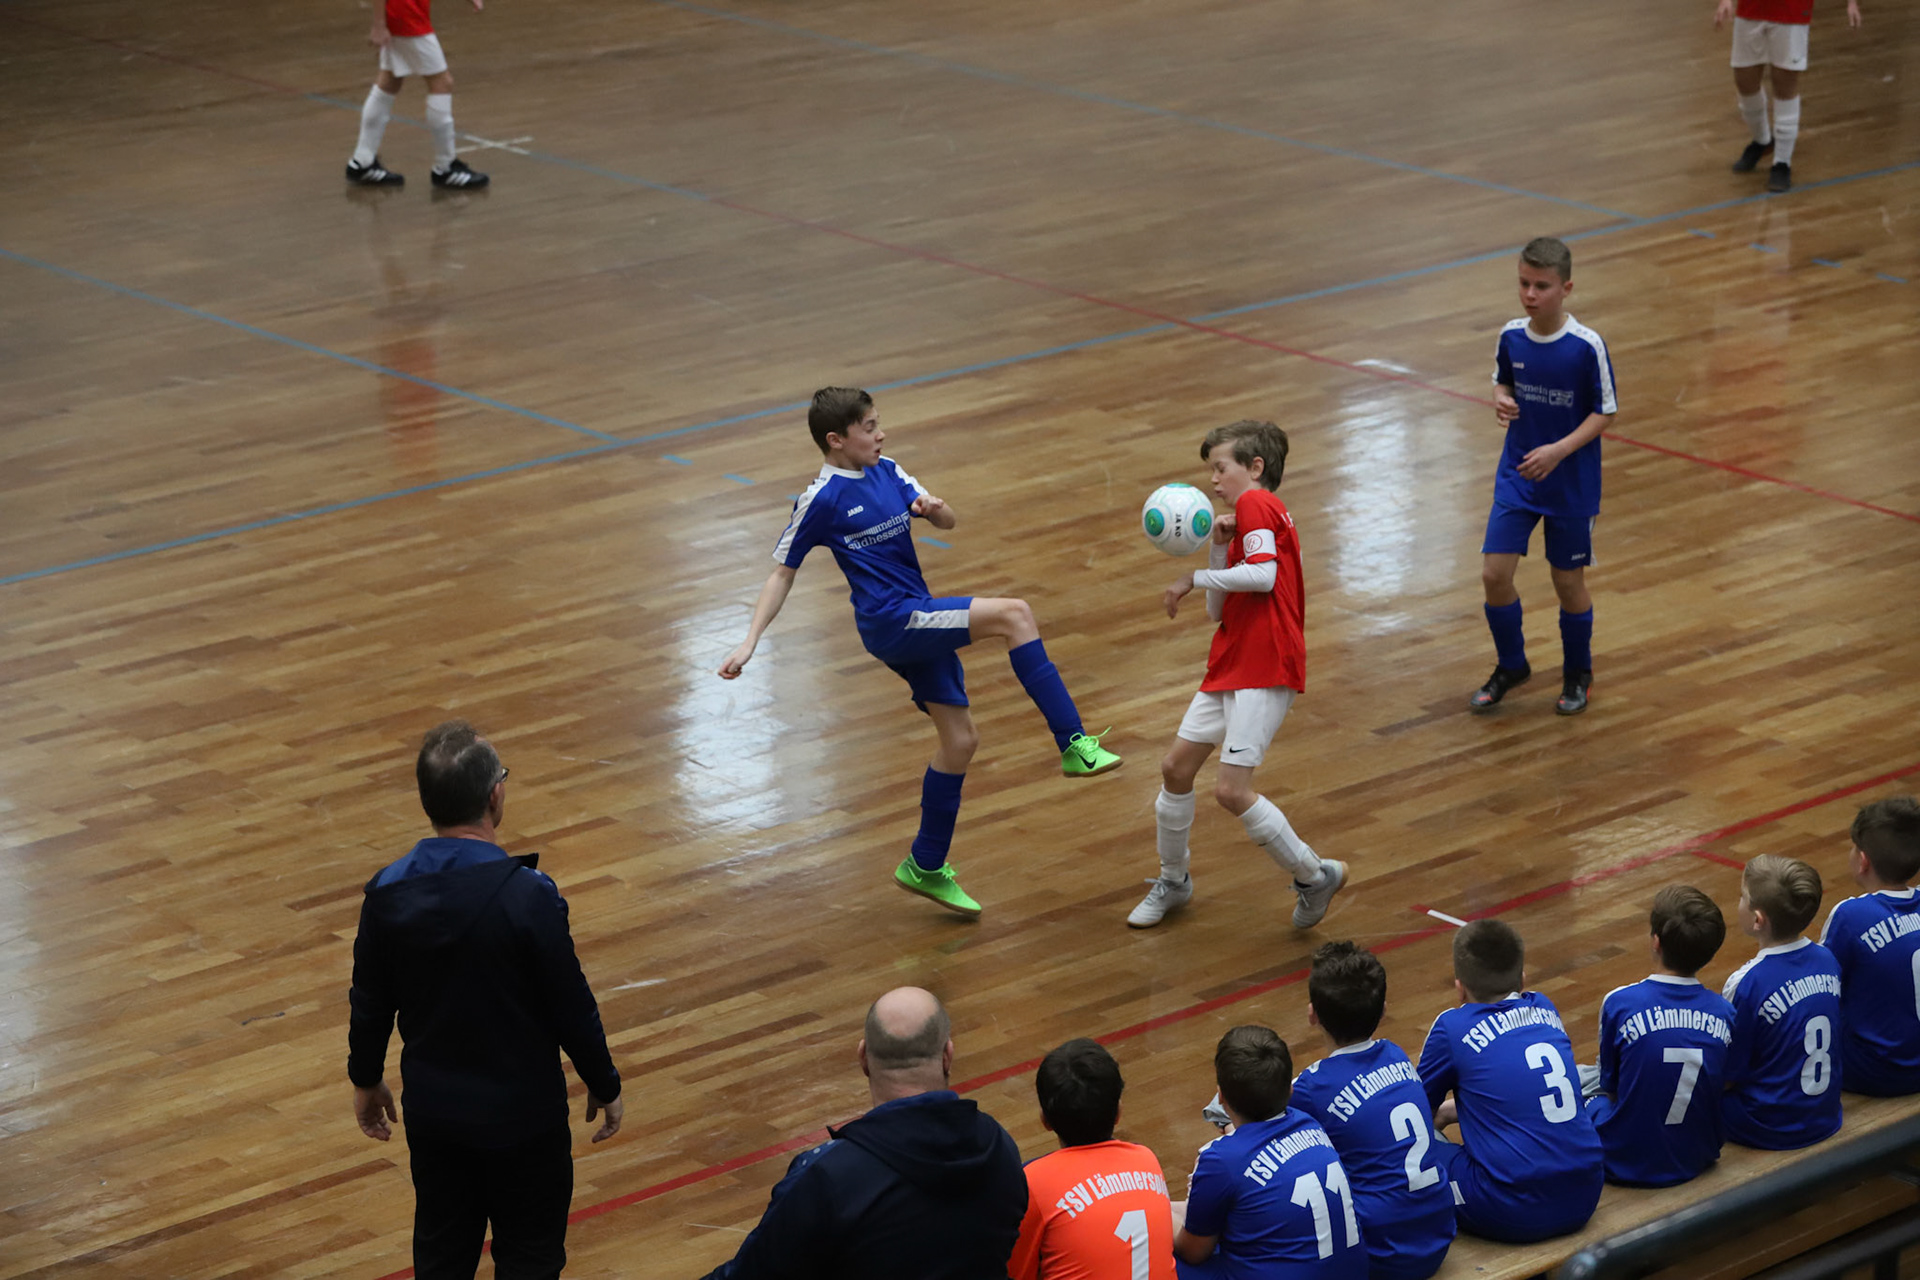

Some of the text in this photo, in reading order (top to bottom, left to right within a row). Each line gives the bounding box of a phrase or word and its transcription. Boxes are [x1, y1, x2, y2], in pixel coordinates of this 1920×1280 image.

[1860, 920, 1893, 953] TSV
[1758, 991, 1788, 1025] TSV
[1461, 1020, 1496, 1053] TSV
[1619, 1012, 1647, 1045] TSV
[1800, 1015, 1831, 1096] 8
[1524, 1042, 1578, 1123] 3
[1662, 1047, 1703, 1125] 7
[1327, 1086, 1362, 1122] TSV
[1389, 1102, 1440, 1193] 2
[1243, 1150, 1279, 1187] TSV
[1056, 1182, 1094, 1218] TSV
[1290, 1161, 1360, 1260] 11
[1113, 1209, 1150, 1280] 1
